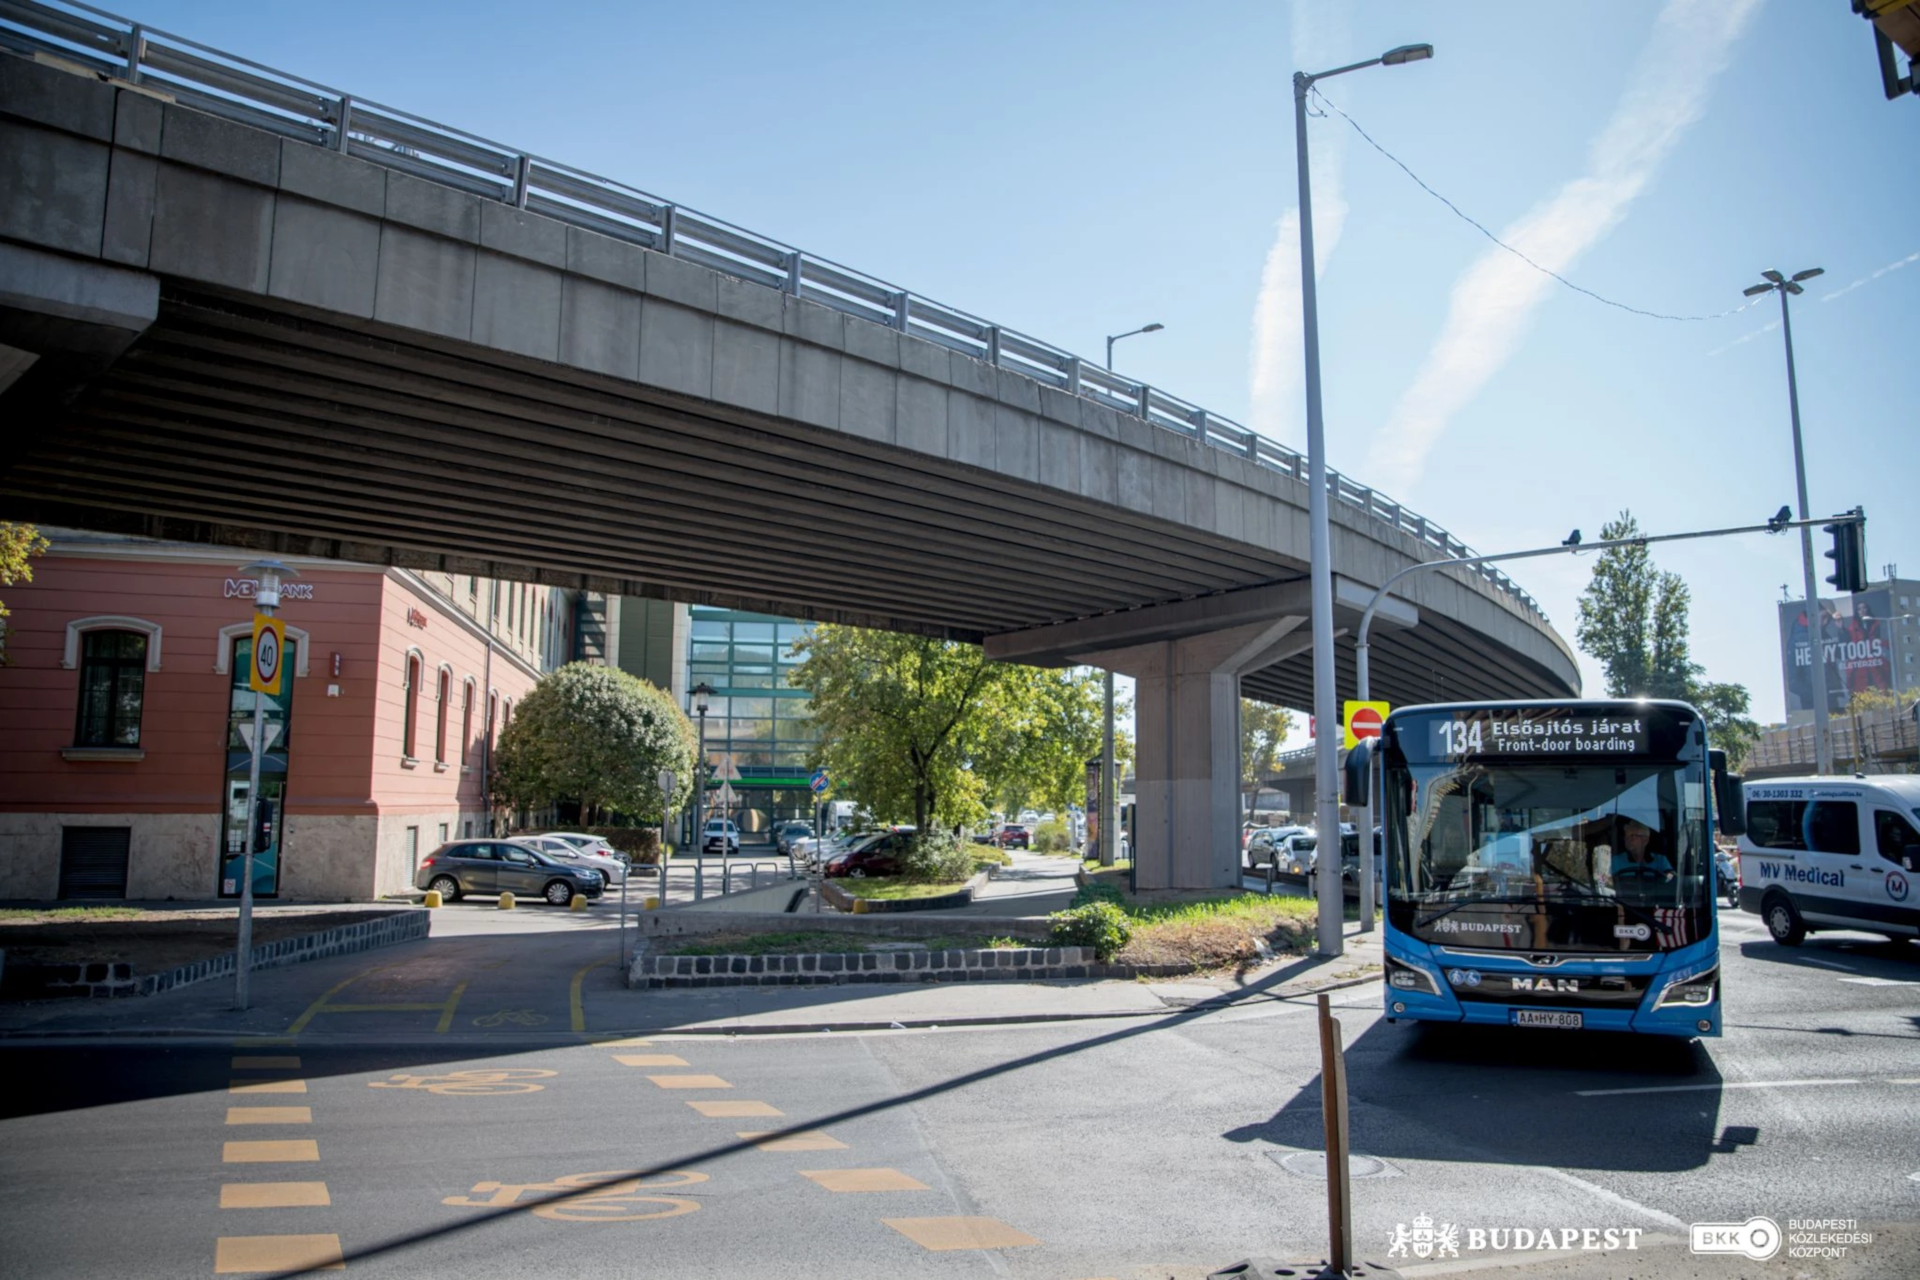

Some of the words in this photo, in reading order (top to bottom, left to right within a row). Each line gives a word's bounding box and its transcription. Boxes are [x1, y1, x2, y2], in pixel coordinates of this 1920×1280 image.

[261, 644, 273, 667] 40
[1795, 643, 1836, 666] HEVY
[1838, 638, 1882, 661] TOOLS
[1438, 721, 1482, 753] 134
[1492, 719, 1584, 736] Elsőajtós
[1590, 719, 1641, 736] járat
[1498, 737, 1571, 751] Front-door
[1575, 737, 1635, 751] boarding
[1760, 862, 1780, 878] MV
[1784, 864, 1845, 887] Medical
[1461, 922, 1522, 934] BUDAPEST
[1511, 977, 1579, 992] MAN
